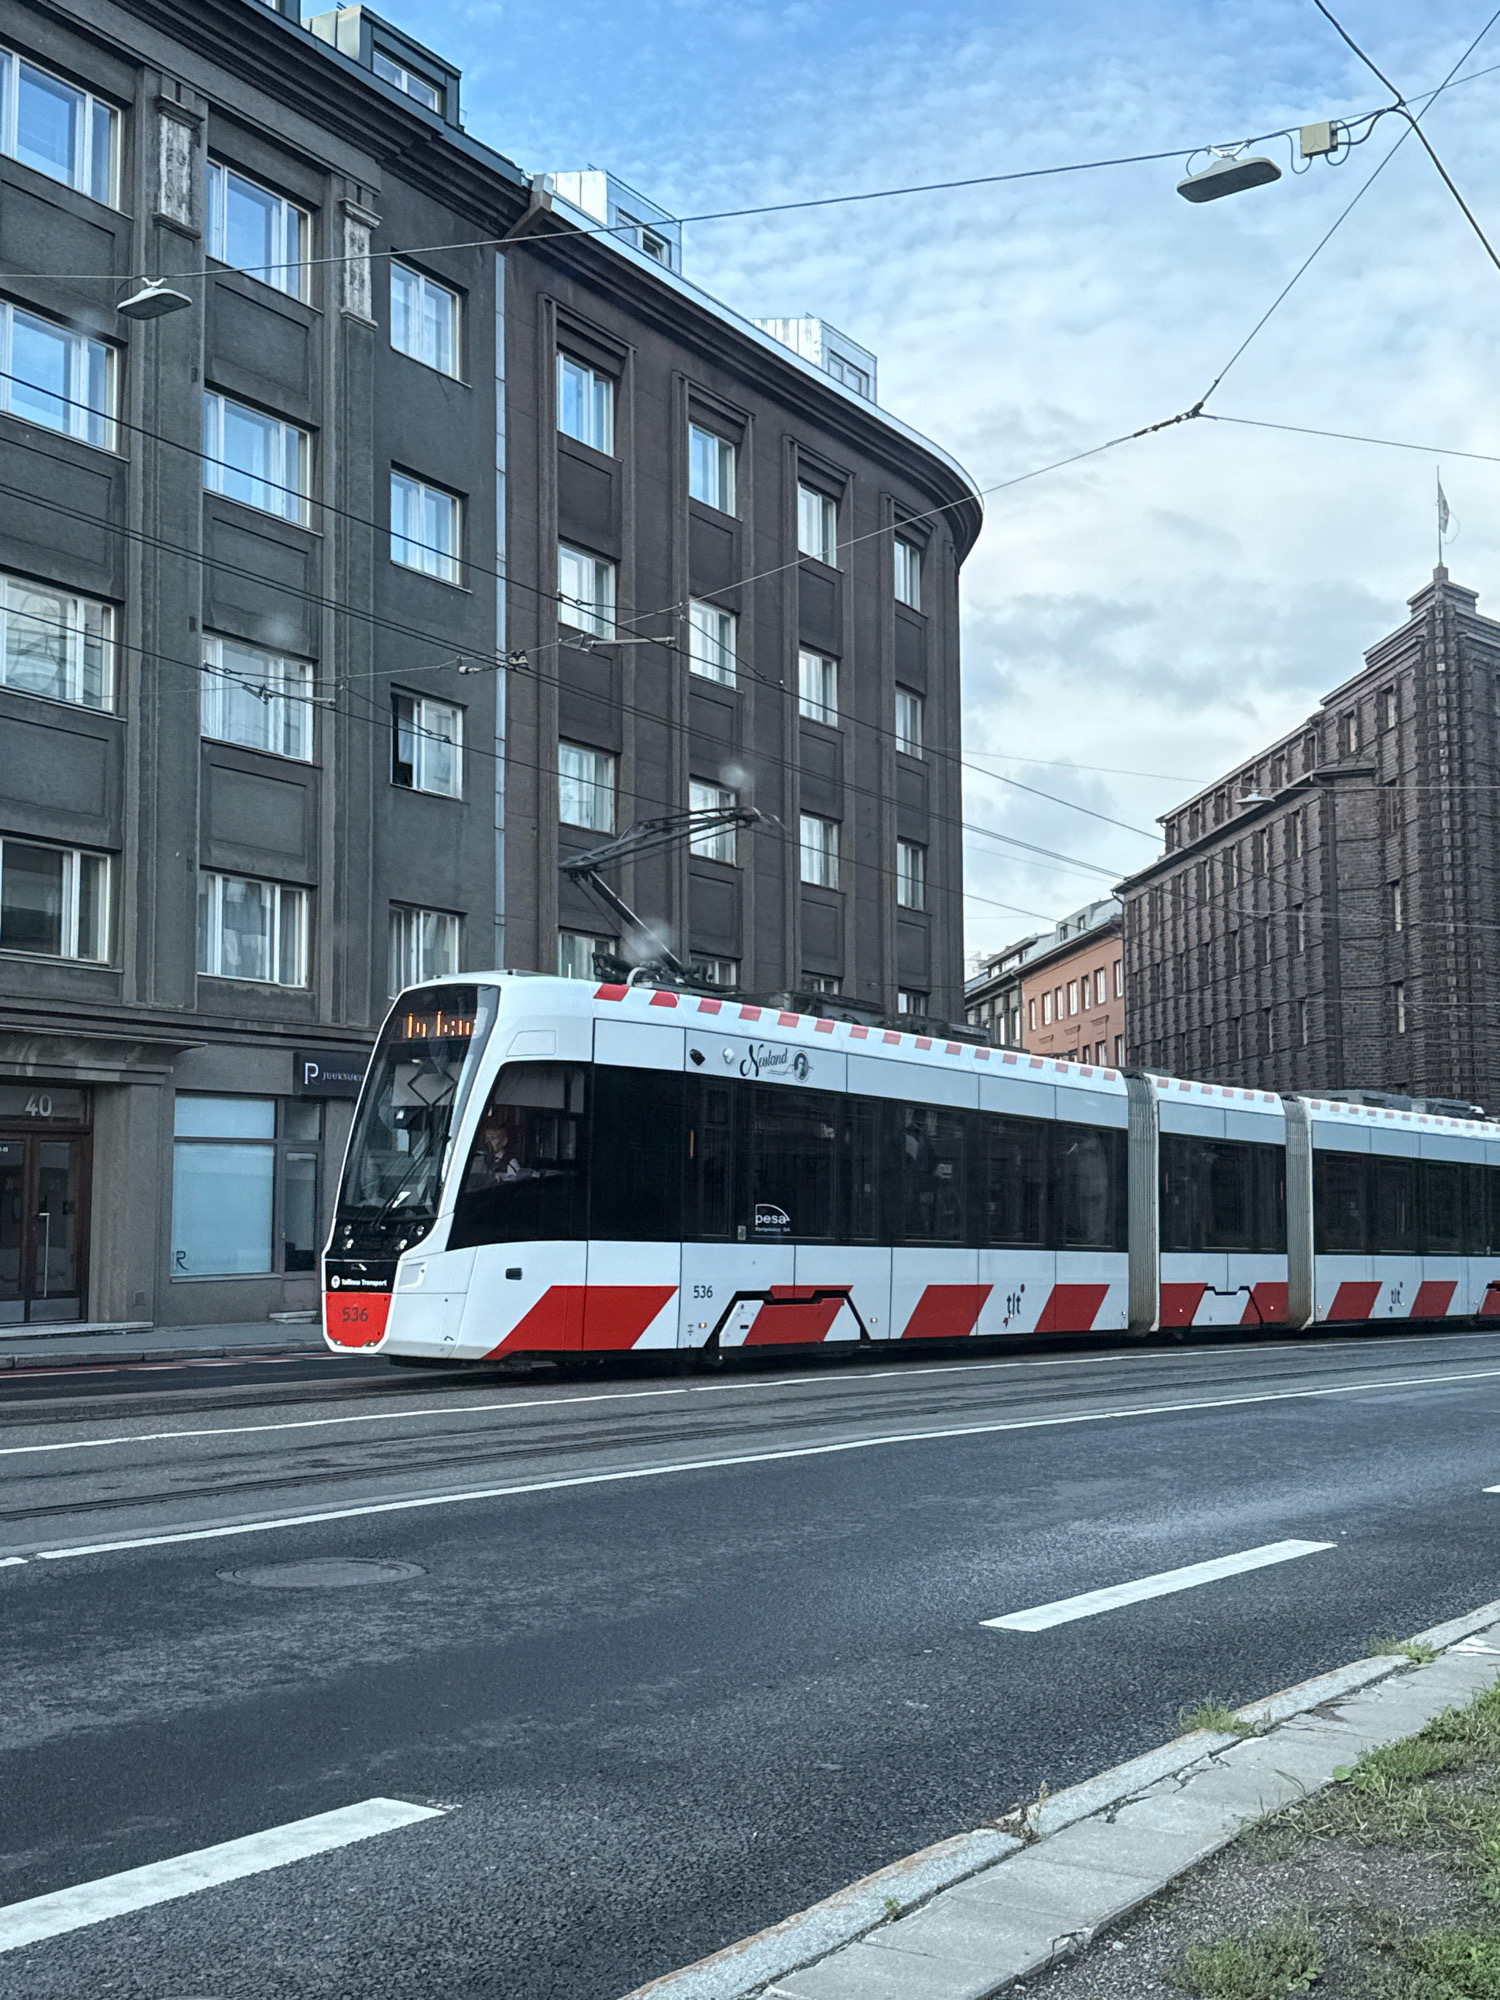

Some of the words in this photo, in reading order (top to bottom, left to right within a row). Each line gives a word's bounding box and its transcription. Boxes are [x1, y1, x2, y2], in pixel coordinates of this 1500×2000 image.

[739, 1043, 788, 1078] Neuland
[24, 1092, 53, 1117] 40
[755, 1214, 787, 1226] pesa
[693, 1284, 714, 1299] 536
[341, 1306, 370, 1323] 536
